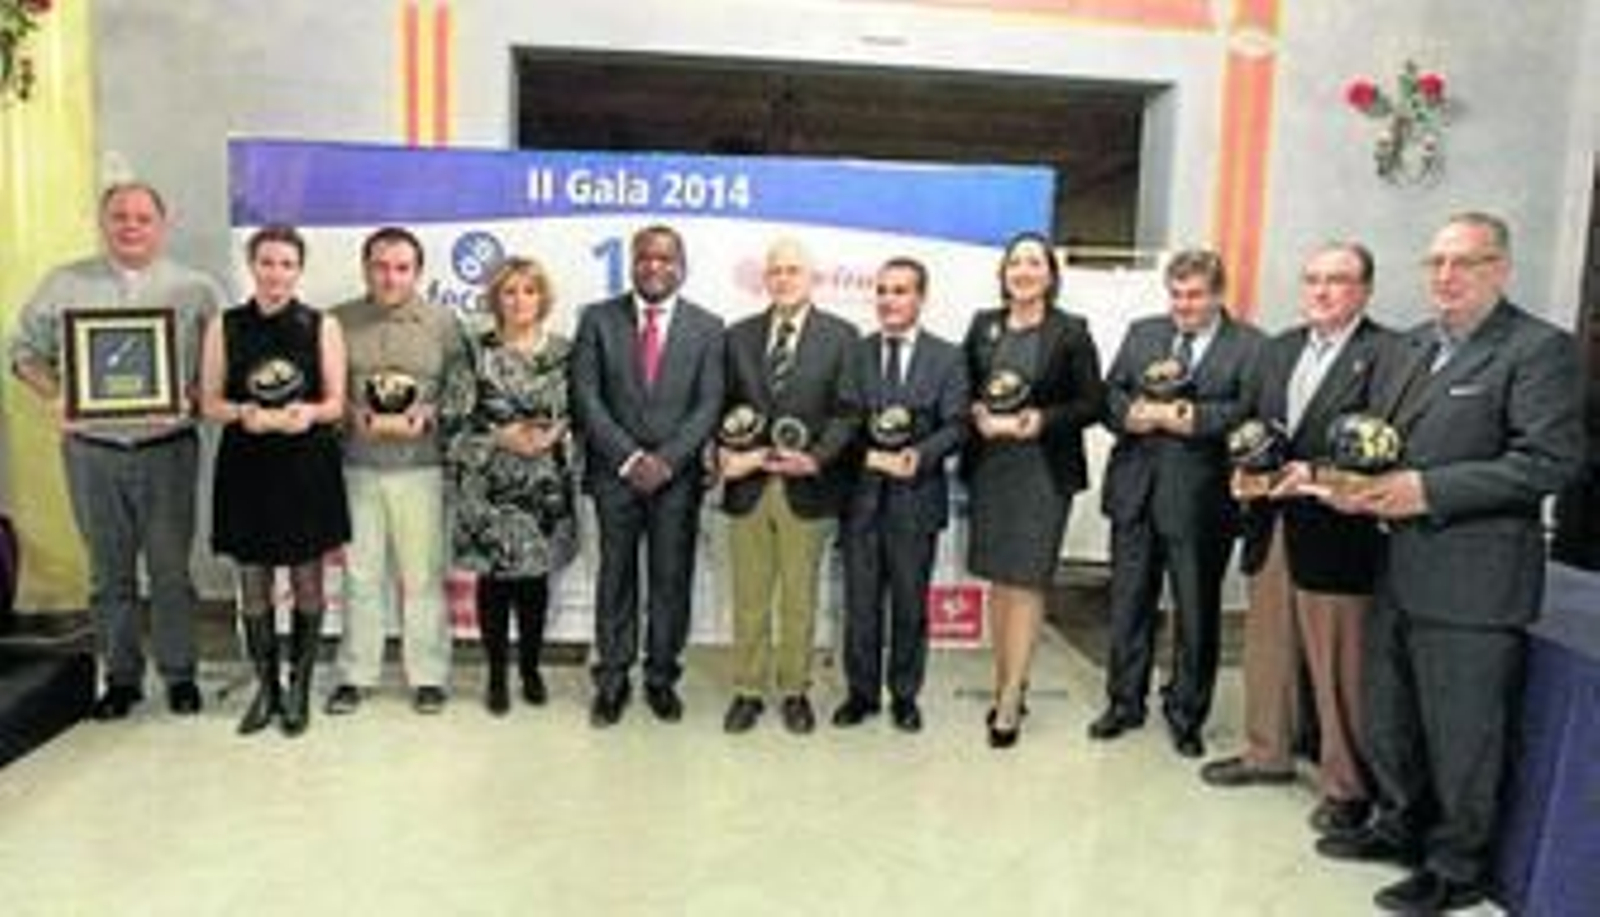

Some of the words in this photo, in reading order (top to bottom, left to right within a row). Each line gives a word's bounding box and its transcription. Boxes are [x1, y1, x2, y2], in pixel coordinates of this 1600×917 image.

[528, 169, 553, 202] II
[566, 169, 649, 205] Gala
[661, 173, 749, 208] 2014
